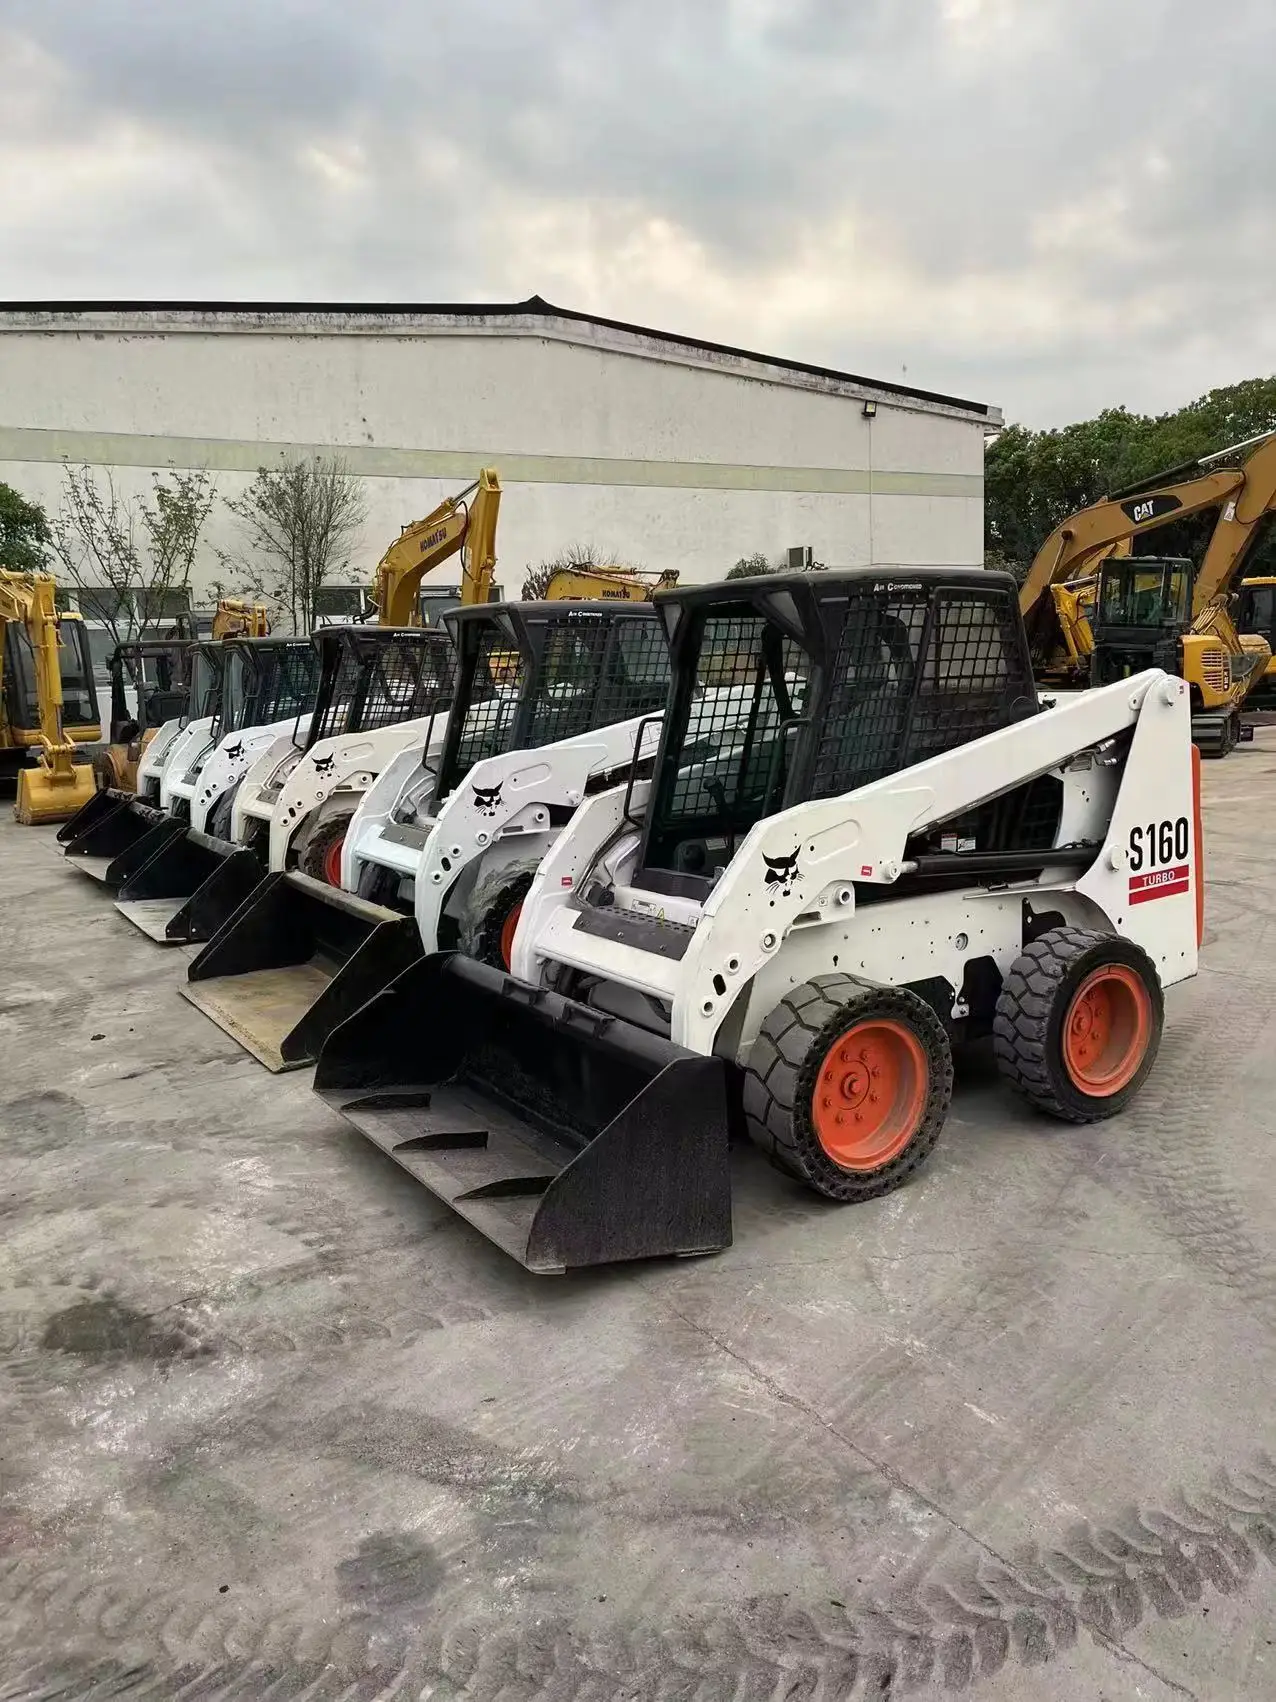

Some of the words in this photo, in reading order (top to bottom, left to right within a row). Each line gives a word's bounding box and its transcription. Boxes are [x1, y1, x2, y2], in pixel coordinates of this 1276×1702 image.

[1133, 500, 1154, 522] CAT
[420, 526, 447, 552] KOMATSU
[602, 586, 630, 599] KOMATSU
[1129, 816, 1189, 872] S160
[1142, 870, 1176, 887] TURBO
